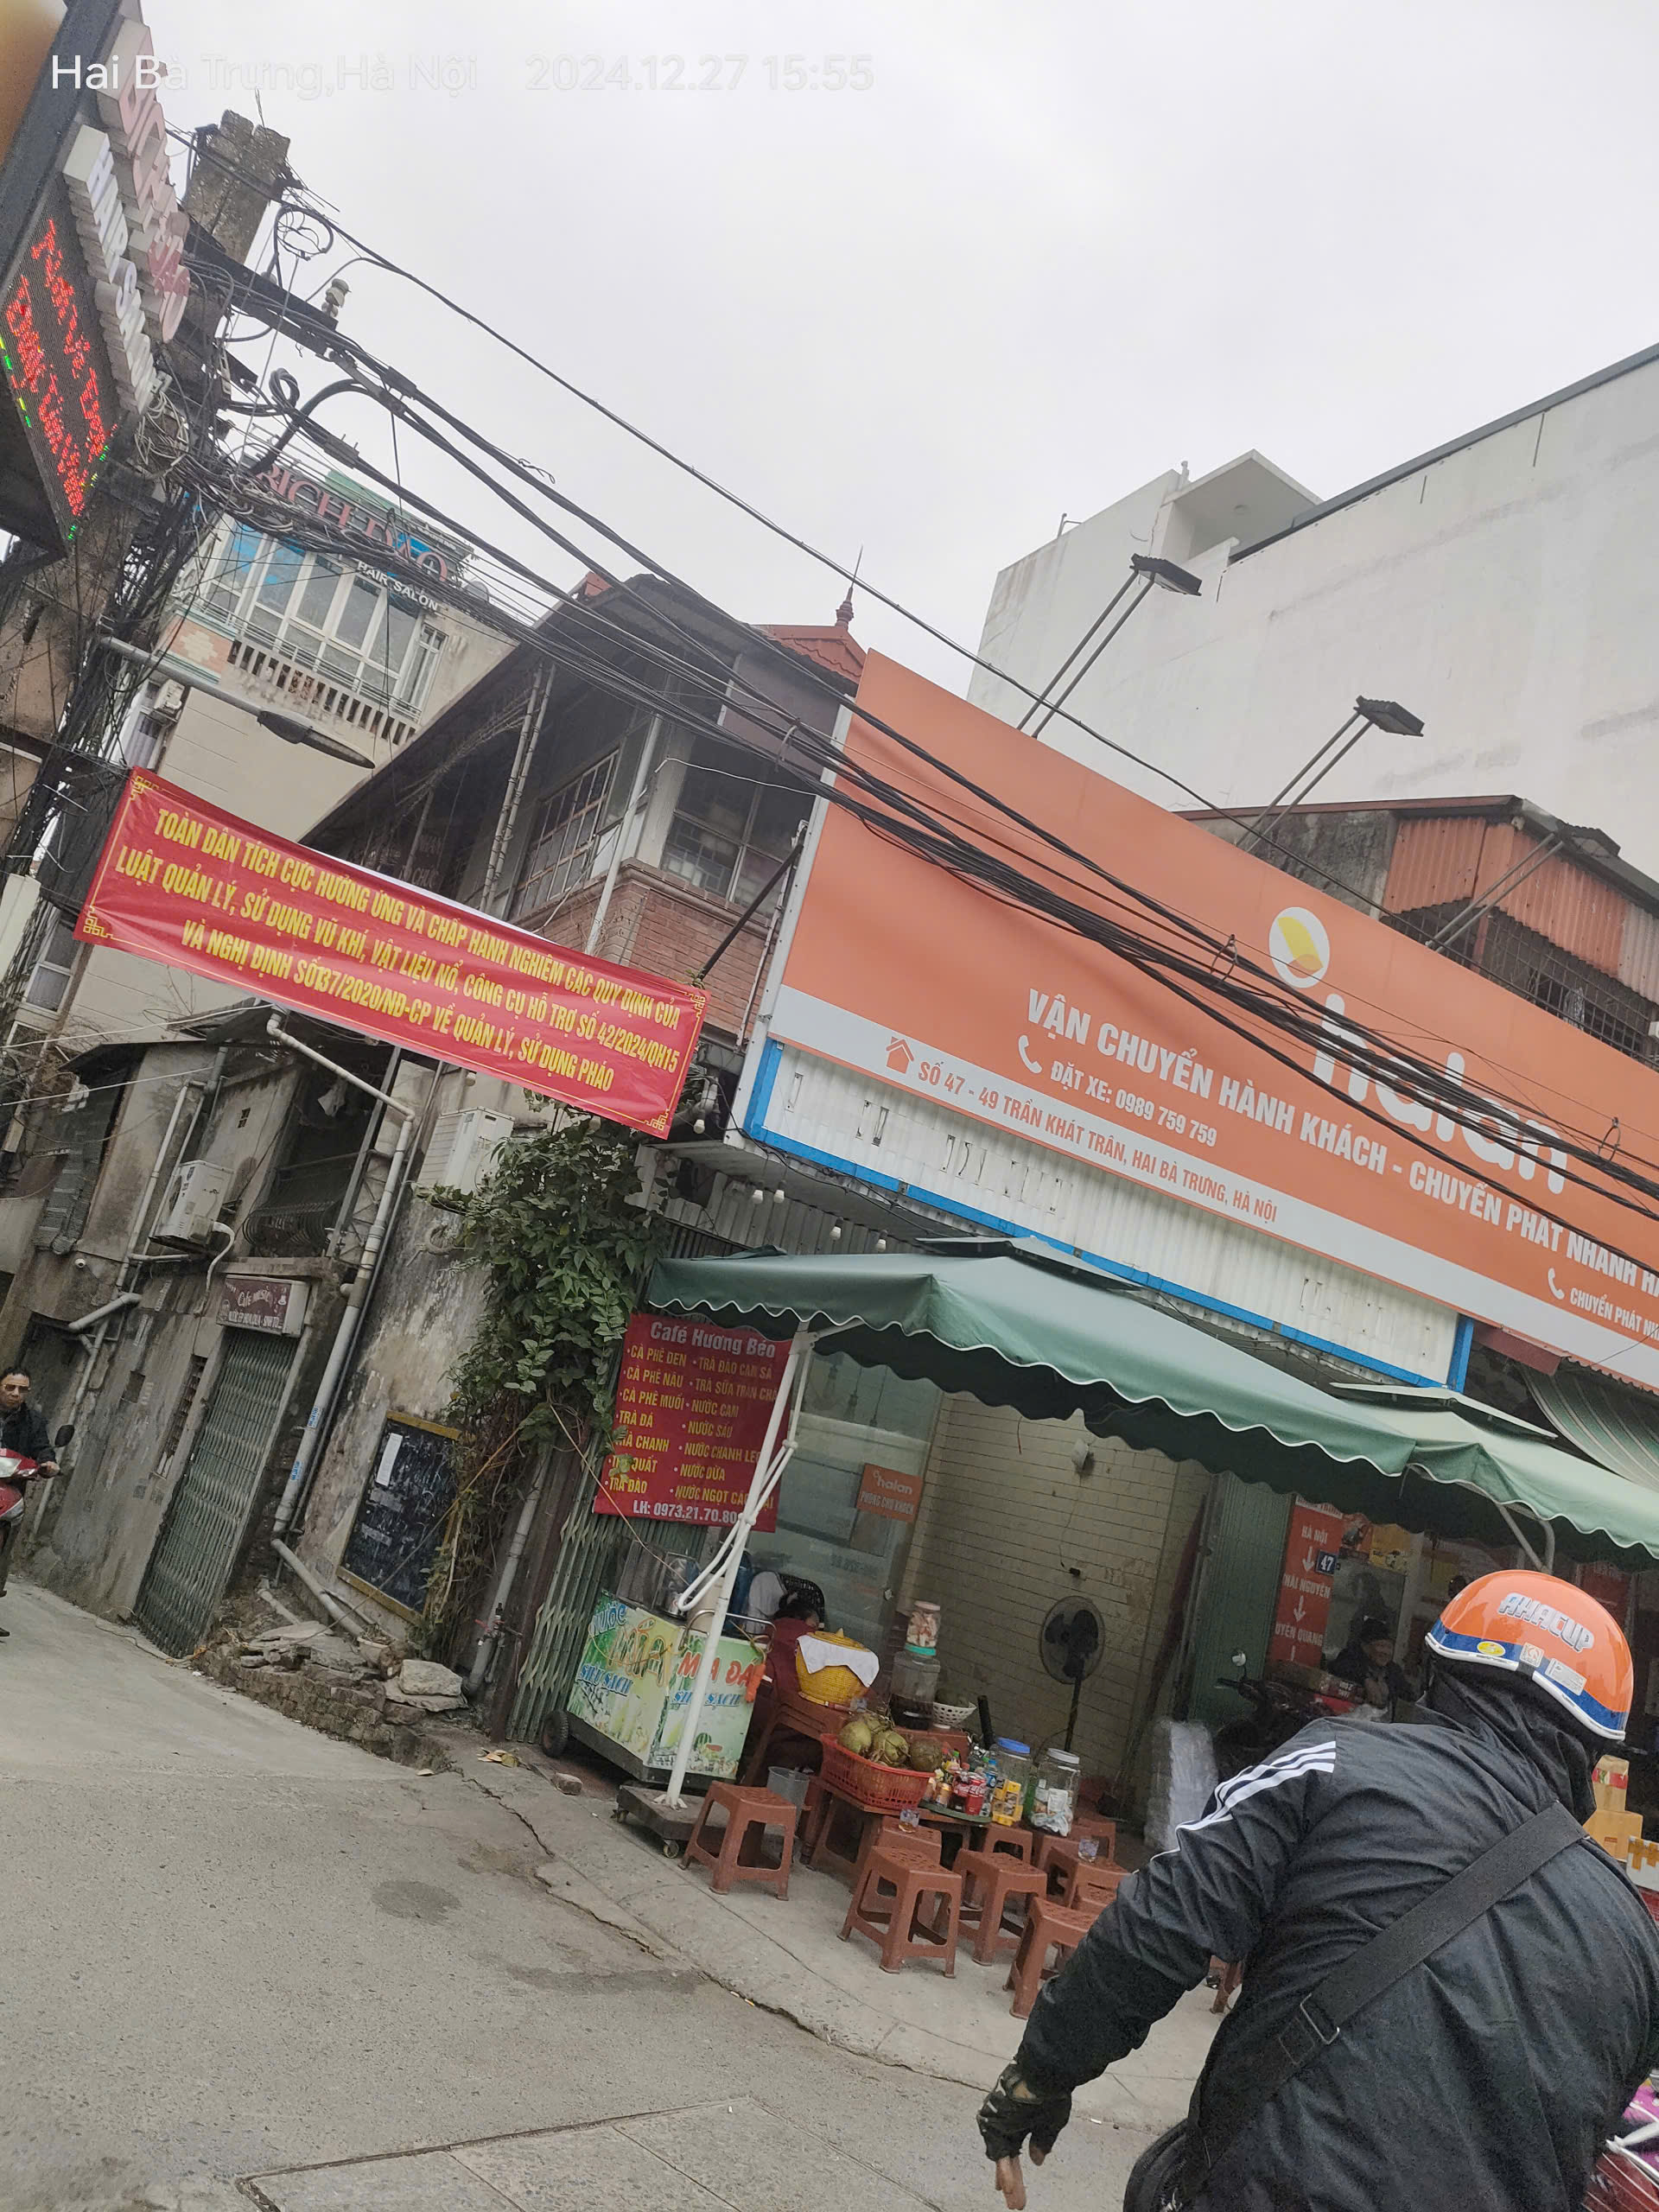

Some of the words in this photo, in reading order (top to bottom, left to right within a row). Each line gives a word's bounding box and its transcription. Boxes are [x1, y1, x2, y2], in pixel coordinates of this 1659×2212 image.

[357, 560, 389, 589] HAIR
[392, 581, 439, 611] SALON
[154, 809, 203, 849] TOÀN
[201, 827, 241, 862] DÂN
[241, 841, 277, 879] TÍCH
[280, 854, 315, 893] CỰC
[315, 874, 371, 913] HƯỞNG
[371, 889, 404, 926] ỨNG
[406, 905, 427, 935] VÀ
[427, 914, 467, 948] CHẤP
[467, 928, 510, 965] HÀNH
[508, 944, 565, 987] NGHIÊM
[565, 962, 593, 997] CÁC
[592, 978, 621, 1007] QUY
[621, 986, 653, 1020] ĐỊNH
[653, 996, 682, 1031] CỦA
[114, 845, 163, 887] LUẬT
[162, 862, 214, 903] QUẢN
[211, 880, 237, 916] LÝ,
[240, 887, 270, 922] SỬ
[266, 900, 312, 940] DỤNG
[314, 917, 339, 948] VŨ
[336, 926, 367, 963] KHÍ,
[370, 938, 403, 974] VẬT
[399, 950, 434, 986] LIỆU
[434, 959, 465, 995] NỔ,
[462, 973, 505, 1007] CÔNG
[504, 987, 527, 1018] CỤ
[527, 991, 550, 1022] HỖ
[550, 1004, 577, 1035] TRỢ
[576, 1009, 601, 1041] SỐ
[596, 1020, 680, 1073] 42/2024/QH15
[181, 918, 206, 950] VÀ
[205, 929, 251, 971] NGHỊ
[250, 944, 294, 981] ĐỊNH
[432, 1001, 455, 1032] VỀ
[453, 1012, 494, 1048] QUẢN
[493, 1027, 516, 1061] LÝ,
[517, 1033, 543, 1065] SỬ
[538, 1045, 578, 1080] DỤNG
[578, 1058, 615, 1093] PHÁO
[1051, 1059, 1084, 1090] ĐẶT
[1084, 1073, 1112, 1104] XE:
[1116, 1087, 1155, 1122] 0989
[1159, 1105, 1186, 1135] 759
[1189, 1118, 1217, 1147] 759
[1313, 993, 1567, 1194] halan
[918, 1059, 944, 1087] SỐ
[944, 1072, 965, 1096] 47
[978, 1085, 1000, 1110] 49
[1003, 1095, 1044, 1128] TRẦN
[1045, 1110, 1085, 1146] KHÁT
[1132, 1148, 1158, 1175] HAI
[1159, 1159, 1179, 1184] BÀ
[1182, 1169, 1230, 1206] TRƯNG,
[1232, 1188, 1251, 1214] HÀ
[1253, 1197, 1278, 1224] NỘI
[1027, 988, 1091, 1046] VẬN
[1097, 1022, 1216, 1099] CHUYỂN
[1218, 1075, 1298, 1135] HÀNH
[1300, 1112, 1389, 1175] KHÁCH
[1505, 1203, 1565, 1253] PHÁT
[1567, 1230, 1637, 1287] NHANH
[1570, 1287, 1614, 1321] CHUYỂN
[1613, 1306, 1643, 1333] PHÁT
[651, 1321, 688, 1344] Café
[691, 1327, 742, 1356] Hương
[746, 1338, 776, 1357] Béo
[630, 1343, 644, 1359] CÀ
[646, 1348, 665, 1363] PHÊ
[626, 1365, 640, 1382] CÀ
[643, 1369, 662, 1384] PHÊ
[663, 1371, 683, 1389] NÂU
[622, 1386, 637, 1403] CÀ
[639, 1390, 658, 1407] PHÊ
[659, 1392, 685, 1411] MUỐI
[691, 1398, 718, 1415] NƯỚC
[619, 1409, 637, 1426] TRÀ
[687, 1420, 715, 1436] NƯỚC
[635, 1434, 670, 1452] CHANH
[683, 1440, 710, 1458] NƯỚC
[711, 1446, 743, 1462] CHANH
[679, 1462, 706, 1478] NƯỚC
[627, 1477, 648, 1494] ĐÀO
[675, 1484, 701, 1501] NƯỚC
[702, 1488, 729, 1505] NGỌT
[877, 1474, 913, 1496] halan
[632, 1499, 651, 1515] LH:
[653, 1502, 739, 1524] 0973.21.70.80
[1301, 1524, 1313, 1541] HÀ
[1320, 1554, 1334, 1573] 47
[1299, 1578, 1332, 1599] NGUYÊN
[1497, 1592, 1595, 1652] AHACUP
[1298, 1626, 1324, 1646] QUANG
